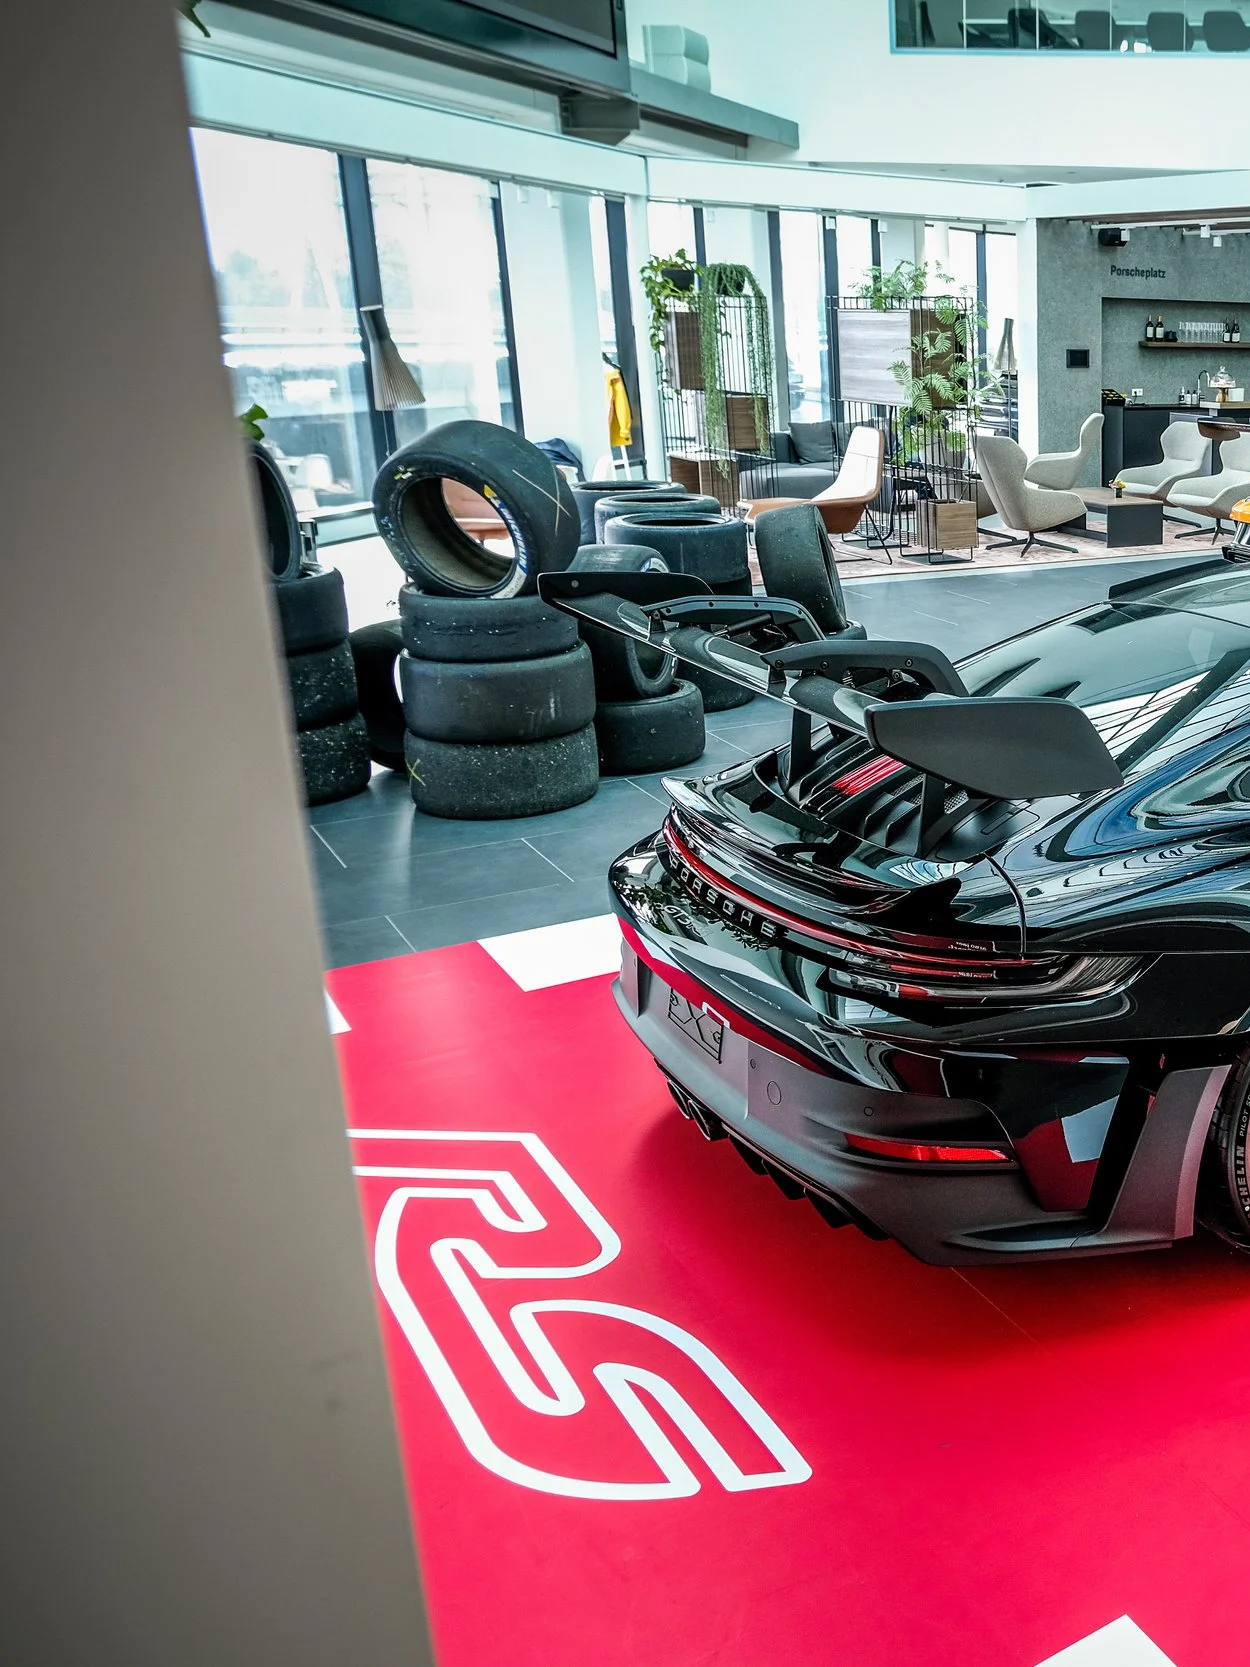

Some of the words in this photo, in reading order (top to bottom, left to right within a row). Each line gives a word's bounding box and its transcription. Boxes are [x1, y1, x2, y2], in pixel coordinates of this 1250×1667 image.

[1110, 264, 1167, 280] Porscheplatz
[500, 508, 528, 569] MICHELIN
[669, 852, 778, 939] PORSCHE
[1239, 1110, 1249, 1137] PILOT
